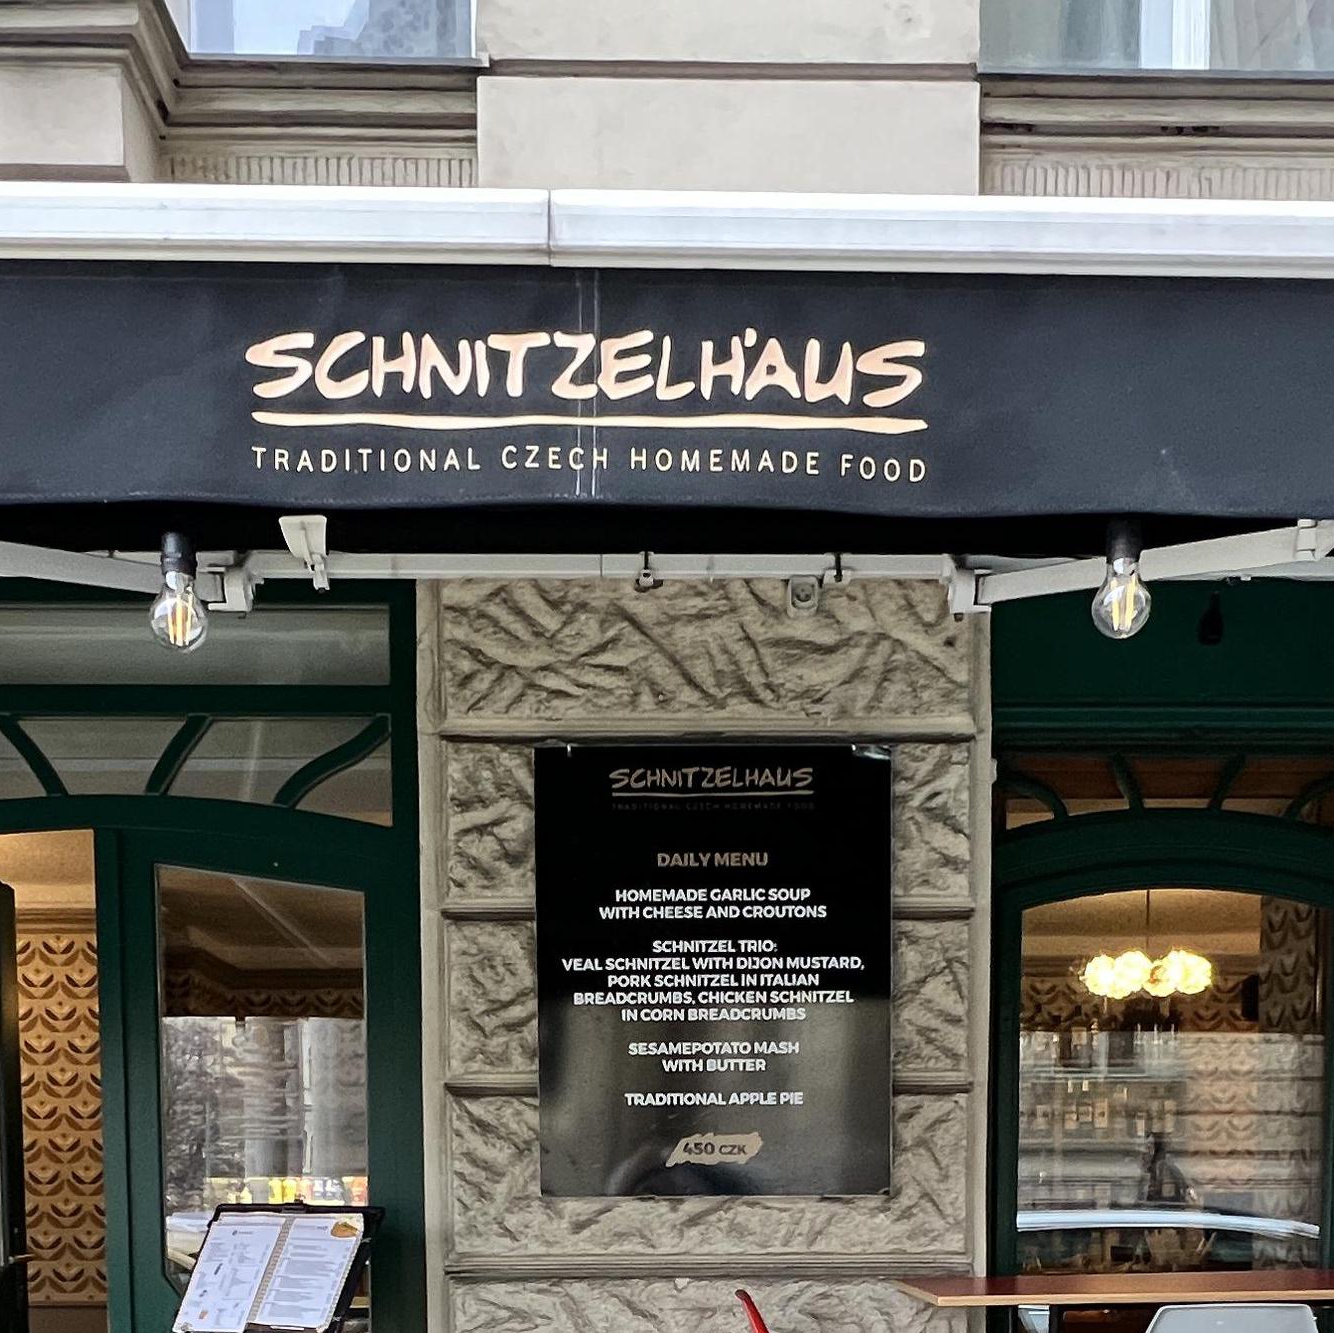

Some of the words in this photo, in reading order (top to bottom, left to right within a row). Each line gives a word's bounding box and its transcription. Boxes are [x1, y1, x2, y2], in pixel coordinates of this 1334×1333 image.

[253, 446, 481, 474] TRADITIONAL
[502, 445, 610, 471] CZECH
[631, 448, 820, 475] HOMEMADE
[841, 454, 927, 483] FOOD
[609, 767, 812, 790] SCHNITZELHAUS
[657, 853, 710, 867] DAILY
[714, 853, 768, 867] MENU
[616, 889, 707, 902] HOMEMADE
[711, 889, 766, 901] GARLIC
[768, 888, 811, 901] SOUP
[599, 906, 640, 919] WITH
[643, 906, 702, 919] CHEESE
[706, 906, 740, 918] AND
[743, 906, 827, 918] CROUTONS
[653, 940, 735, 953] SCHNITZEL
[738, 940, 777, 953] TRIO:
[562, 958, 603, 971] VEAL
[605, 958, 690, 971] SCHNITZEL
[692, 958, 733, 970] WITH
[736, 957, 783, 970] DIJON
[786, 957, 864, 971] MUSTARD,
[608, 975, 651, 987] PORK
[654, 974, 740, 987] SCHNITZEL
[742, 974, 757, 986] IN
[759, 974, 819, 986] ITALIAN
[698, 991, 766, 1004] CHICKEN
[769, 990, 854, 1004] SCHNITZEL
[621, 1008, 637, 1021] IN
[640, 1008, 686, 1021] CORN
[688, 1008, 806, 1021] BREADCRUMBS
[754, 1042, 799, 1055] MASH
[662, 1059, 704, 1072] WITH
[707, 1059, 766, 1072] BUTTER
[625, 1093, 726, 1106] TRADITIONAL
[728, 1093, 777, 1106] APPLE
[779, 1092, 803, 1105] PIE
[682, 1142, 714, 1156] 450
[719, 1143, 746, 1155] CZK
